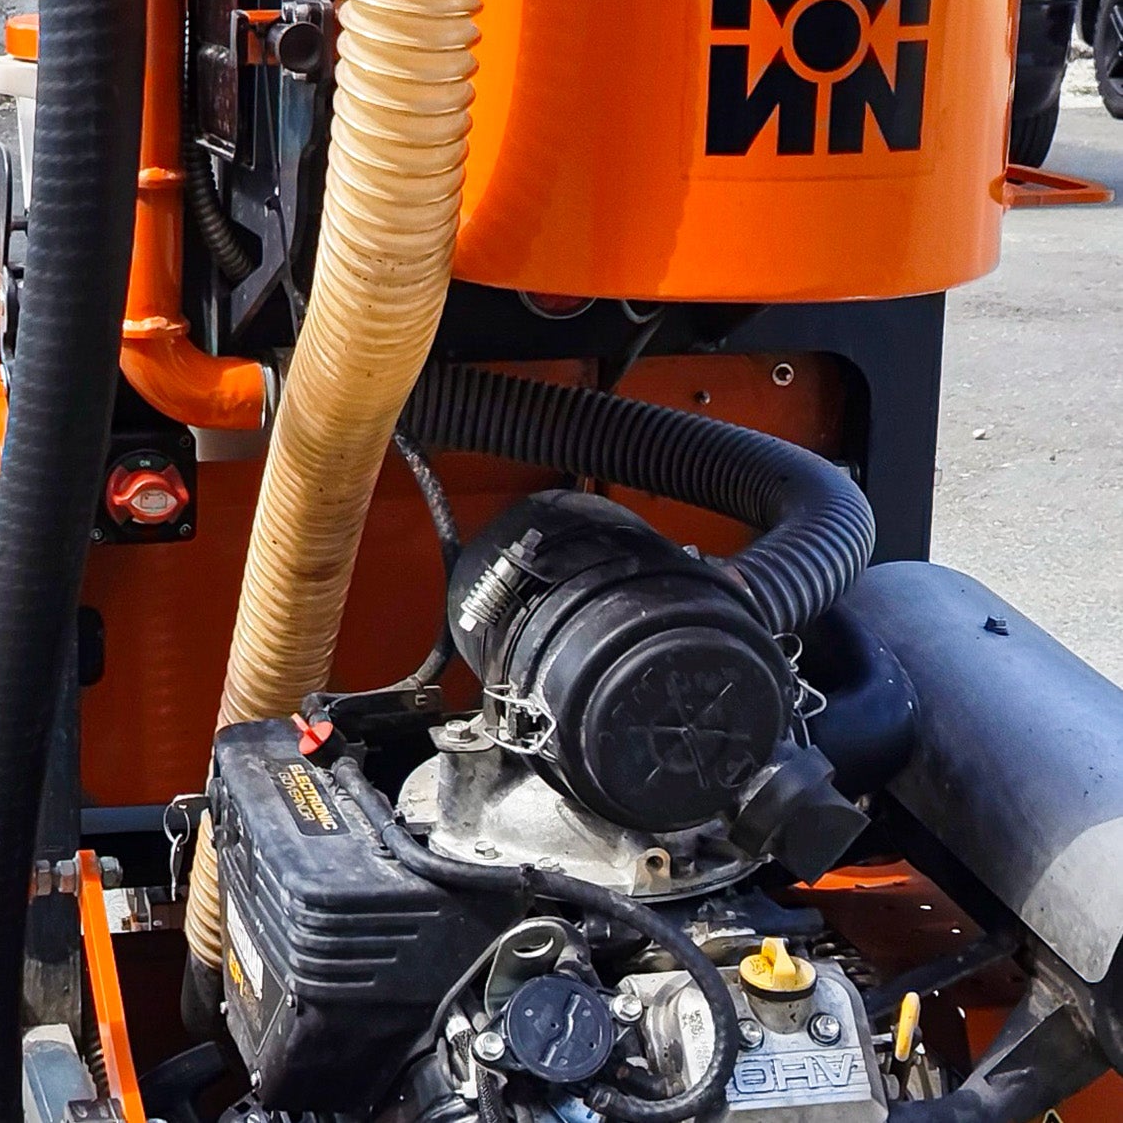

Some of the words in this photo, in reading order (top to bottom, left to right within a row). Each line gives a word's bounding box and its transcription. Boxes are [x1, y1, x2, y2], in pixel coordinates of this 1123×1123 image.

[278, 772, 316, 821] GOVERNOR
[288, 764, 339, 830] ELECTRONIC
[734, 1053, 854, 1094] OHV
